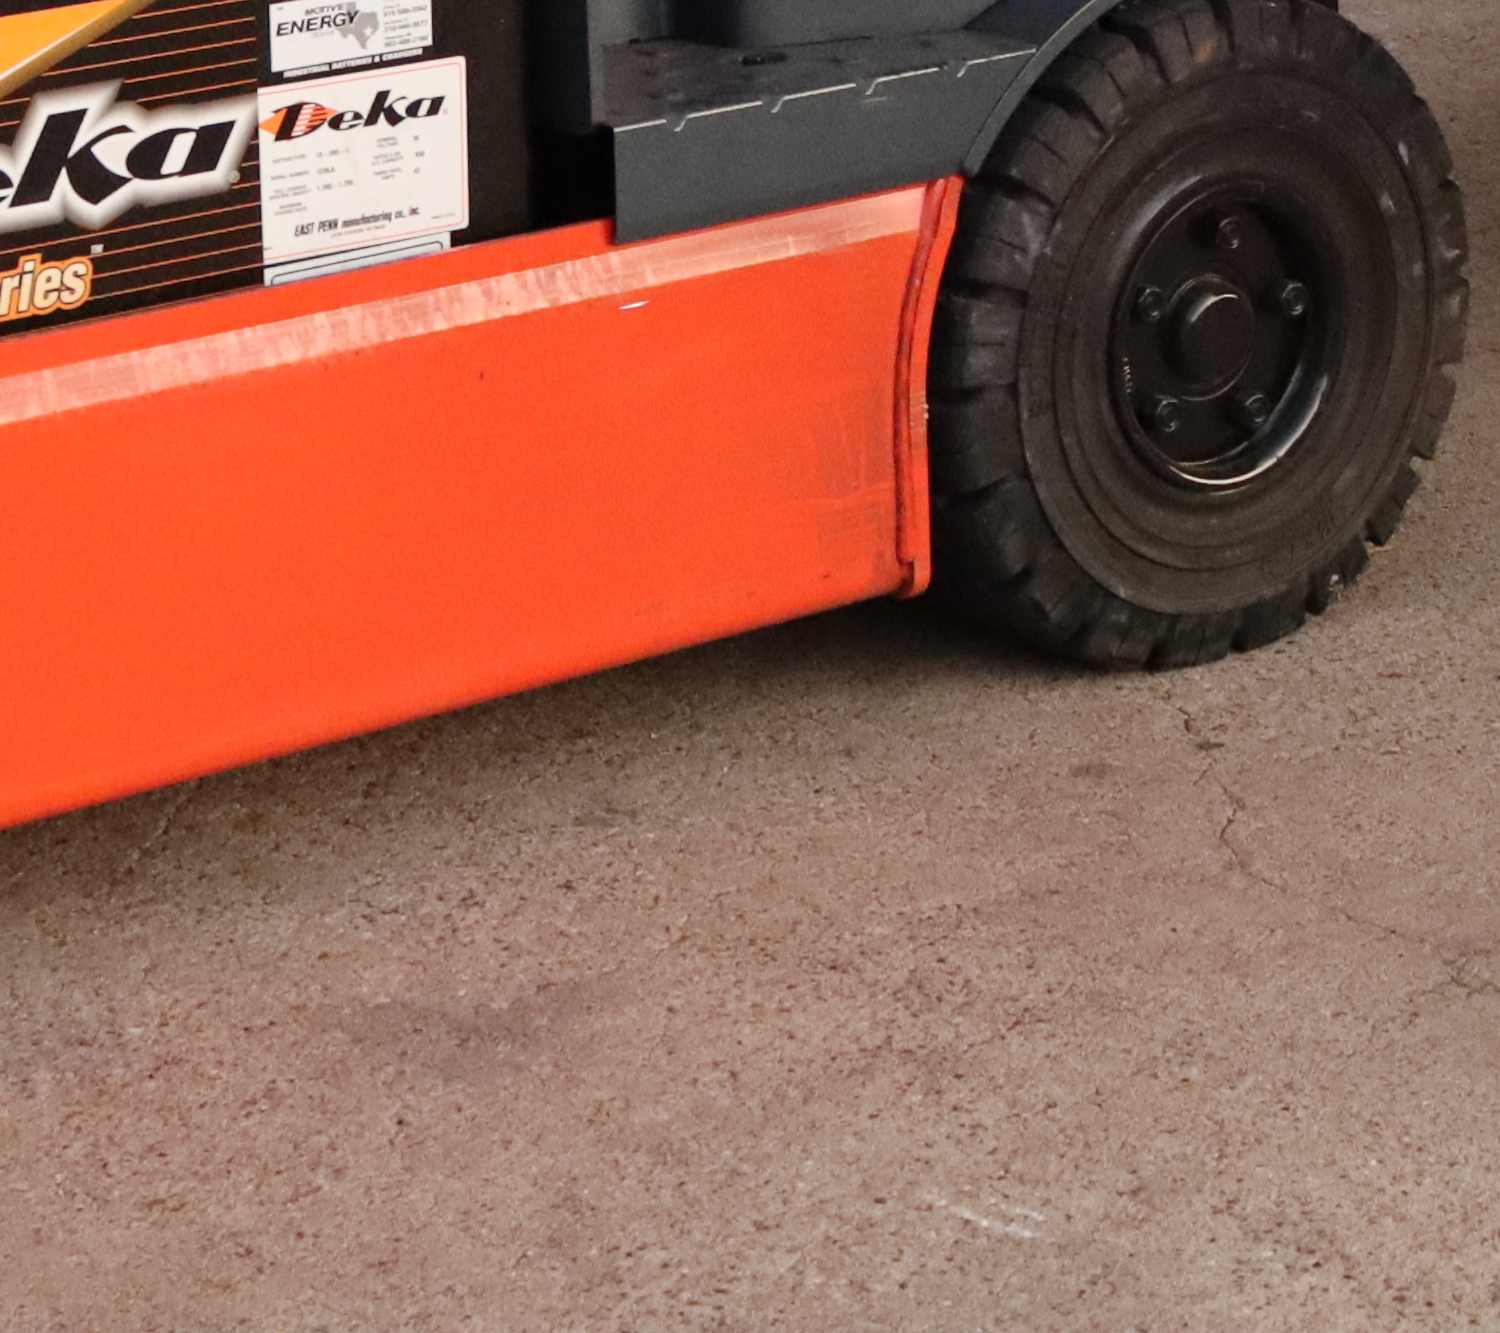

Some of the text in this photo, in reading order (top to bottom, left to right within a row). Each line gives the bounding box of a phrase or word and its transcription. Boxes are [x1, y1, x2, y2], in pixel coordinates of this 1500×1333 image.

[304, 3, 345, 16] MOTIVE
[276, 10, 360, 37] ENERGY
[283, 64, 330, 79] INDUSTRIAL
[270, 89, 446, 143] Deka
[293, 221, 316, 238] EAST
[317, 217, 341, 234] PENN
[341, 211, 393, 229] manufacturing
